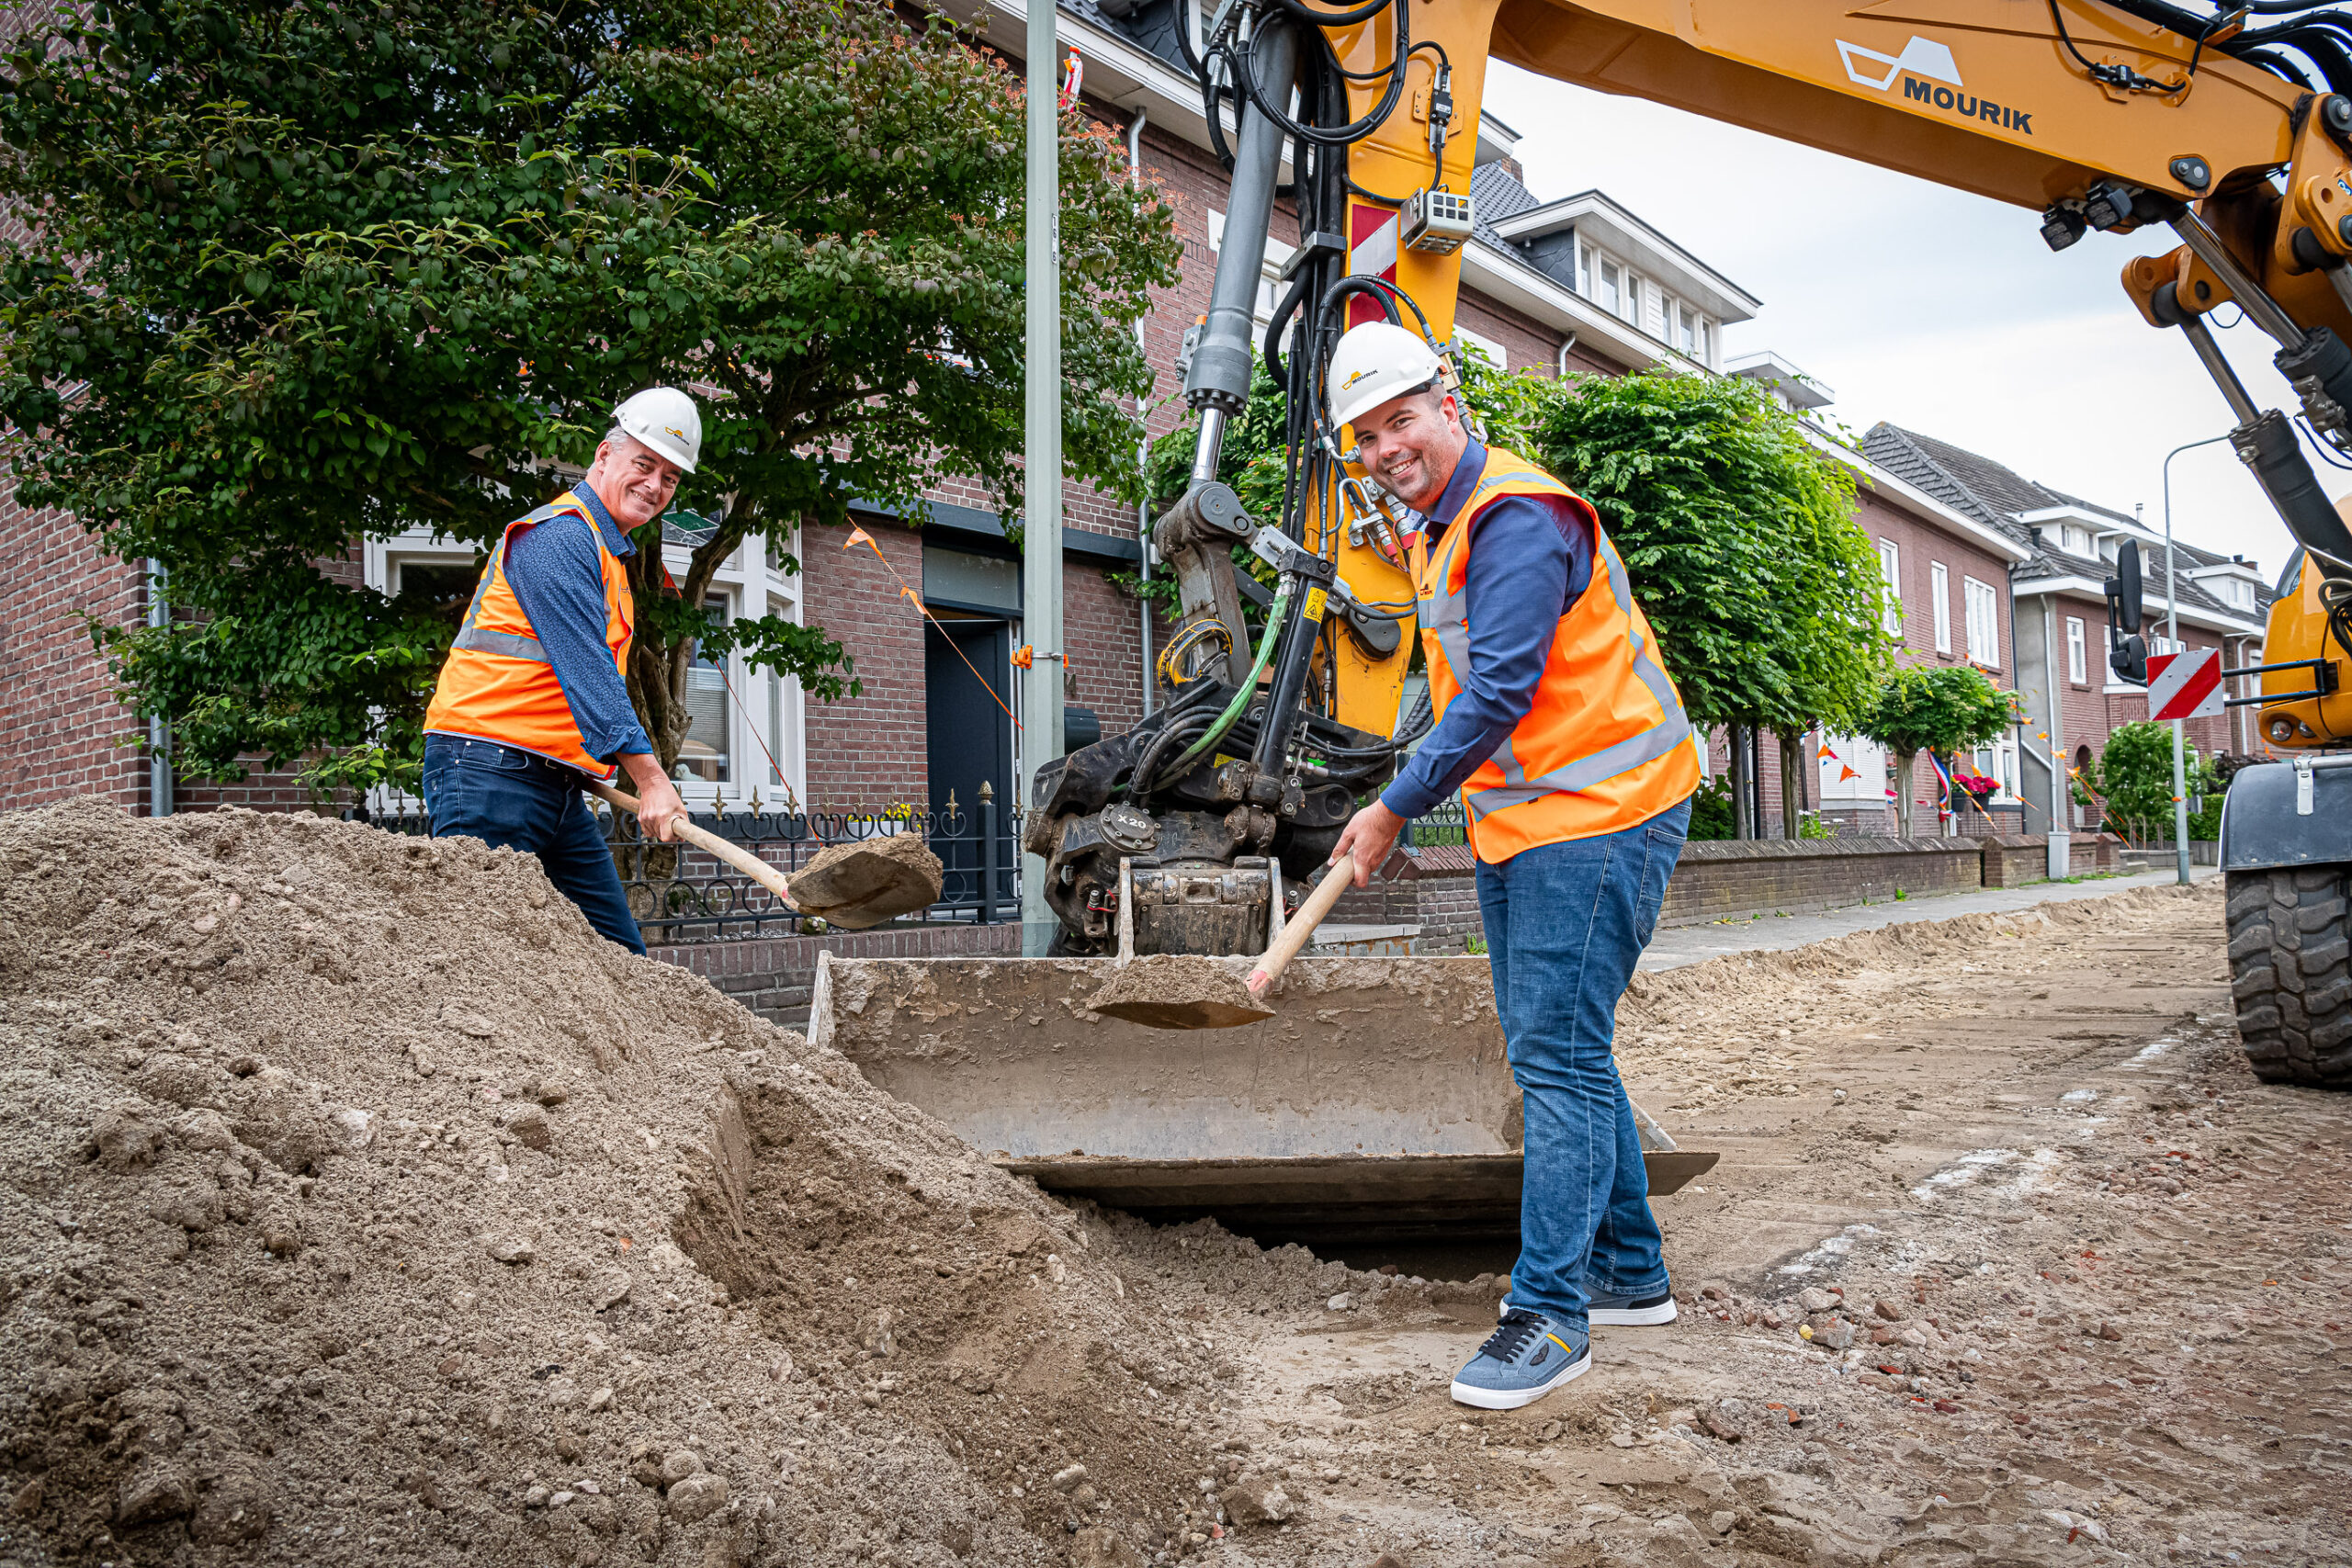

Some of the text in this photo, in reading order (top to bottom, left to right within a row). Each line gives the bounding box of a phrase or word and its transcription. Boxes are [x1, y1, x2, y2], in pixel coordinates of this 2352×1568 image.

[1904, 76, 2034, 135] MOURIK
[1352, 369, 1378, 384] MOURIK
[1117, 814, 1146, 829] X20
